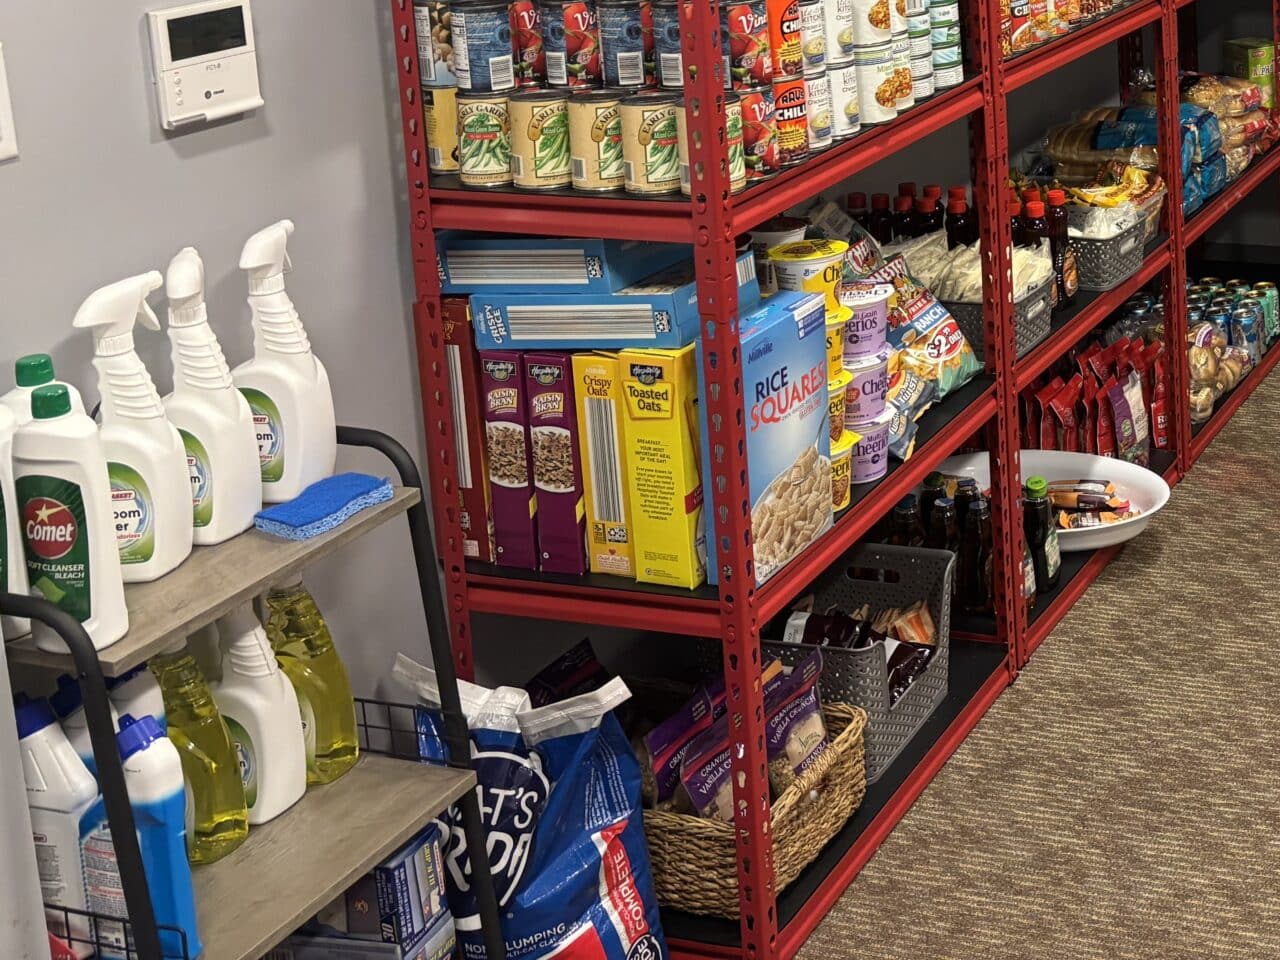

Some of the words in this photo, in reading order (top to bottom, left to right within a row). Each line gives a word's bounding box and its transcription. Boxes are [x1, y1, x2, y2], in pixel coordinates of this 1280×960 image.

[532, 106, 556, 130] EARLY
[643, 110, 666, 134] EARLY
[484, 304, 504, 344] CRISPY
[494, 308, 508, 336] RICE
[914, 304, 946, 331] RANCH
[583, 374, 612, 388] Crispy
[587, 386, 608, 397] Oats
[756, 366, 788, 402] RICE
[488, 390, 516, 402] RAISIN
[489, 398, 513, 408] BRAN
[532, 394, 562, 406] RAISIN
[628, 386, 668, 400] Toasted
[750, 360, 826, 433] SQUARES
[536, 402, 559, 412] BRAN
[637, 398, 662, 412] Oats
[26, 520, 75, 542] Comet
[42, 562, 85, 571] CLEANSER
[54, 572, 85, 580] BLEACH
[801, 740, 826, 769] GRANOLA
[700, 764, 722, 795] VANILLA
[614, 848, 644, 931] COMPLETE
[506, 922, 567, 952] LUMPING
